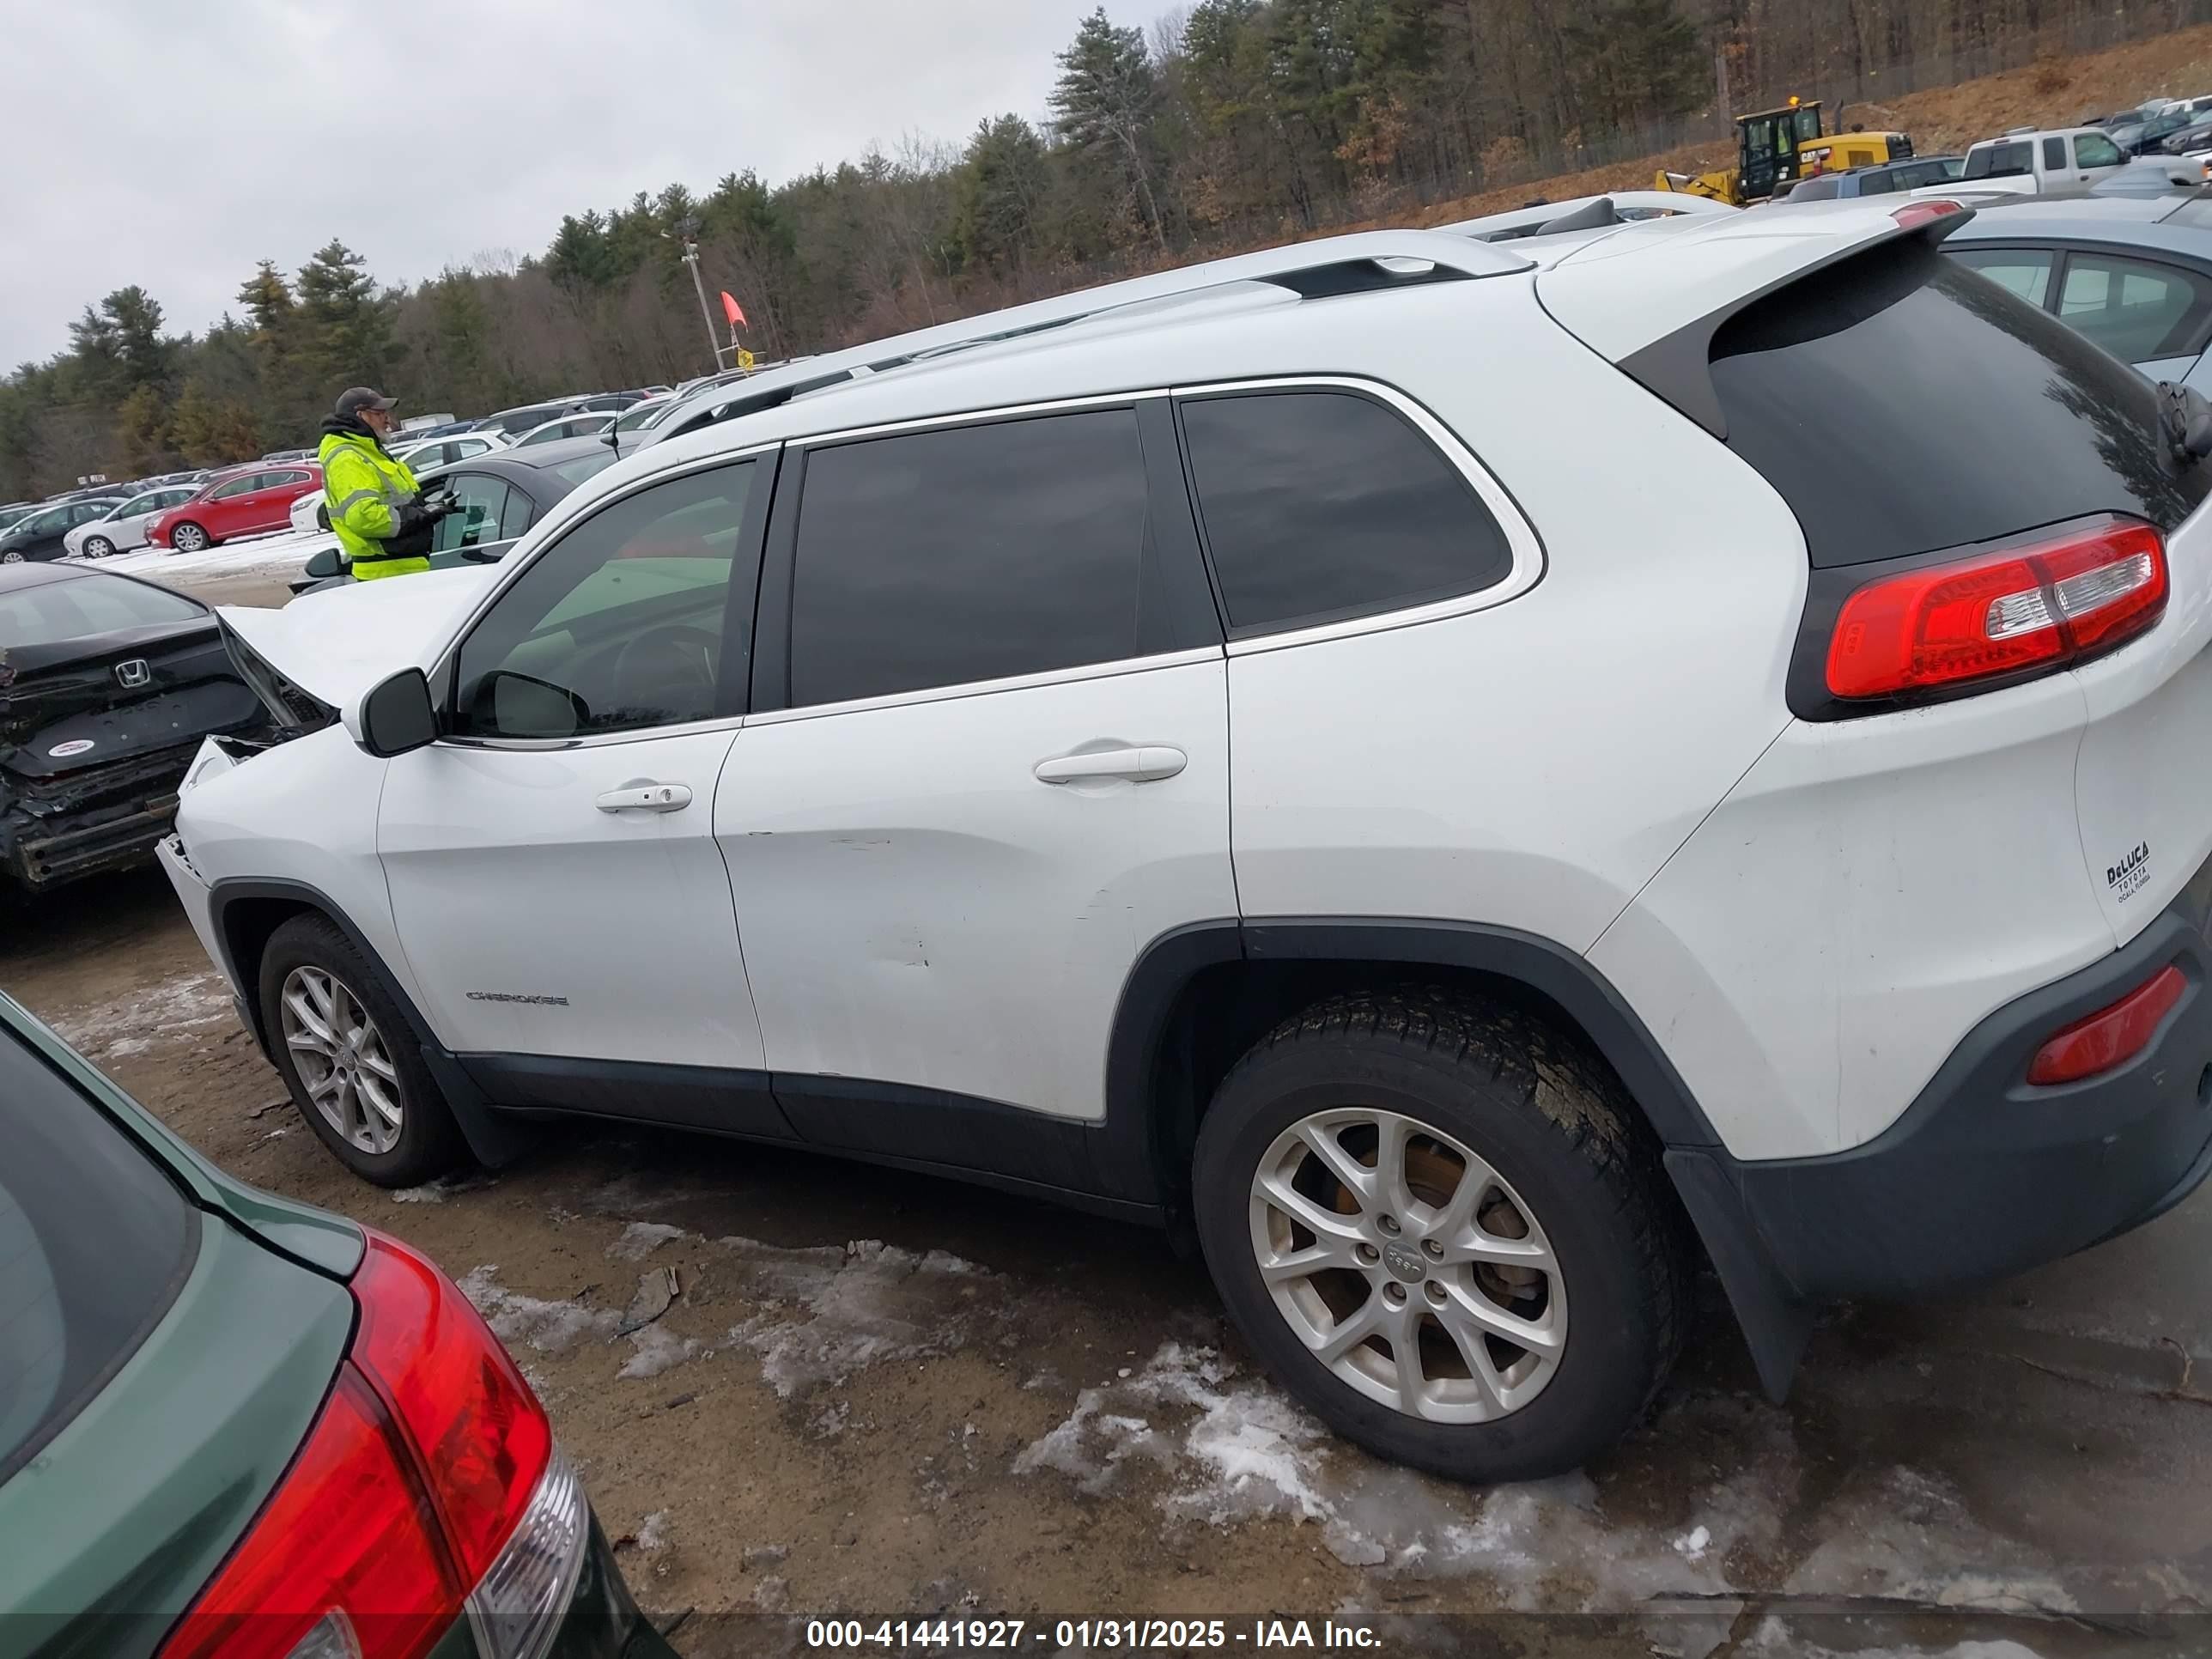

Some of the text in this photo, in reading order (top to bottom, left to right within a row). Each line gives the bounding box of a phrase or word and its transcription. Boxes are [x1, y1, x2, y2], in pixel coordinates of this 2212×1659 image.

[2106, 840, 2149, 884] DeLUCA
[2118, 866, 2147, 892] TOYOTA
[465, 992, 570, 1006] CHEROKEE
